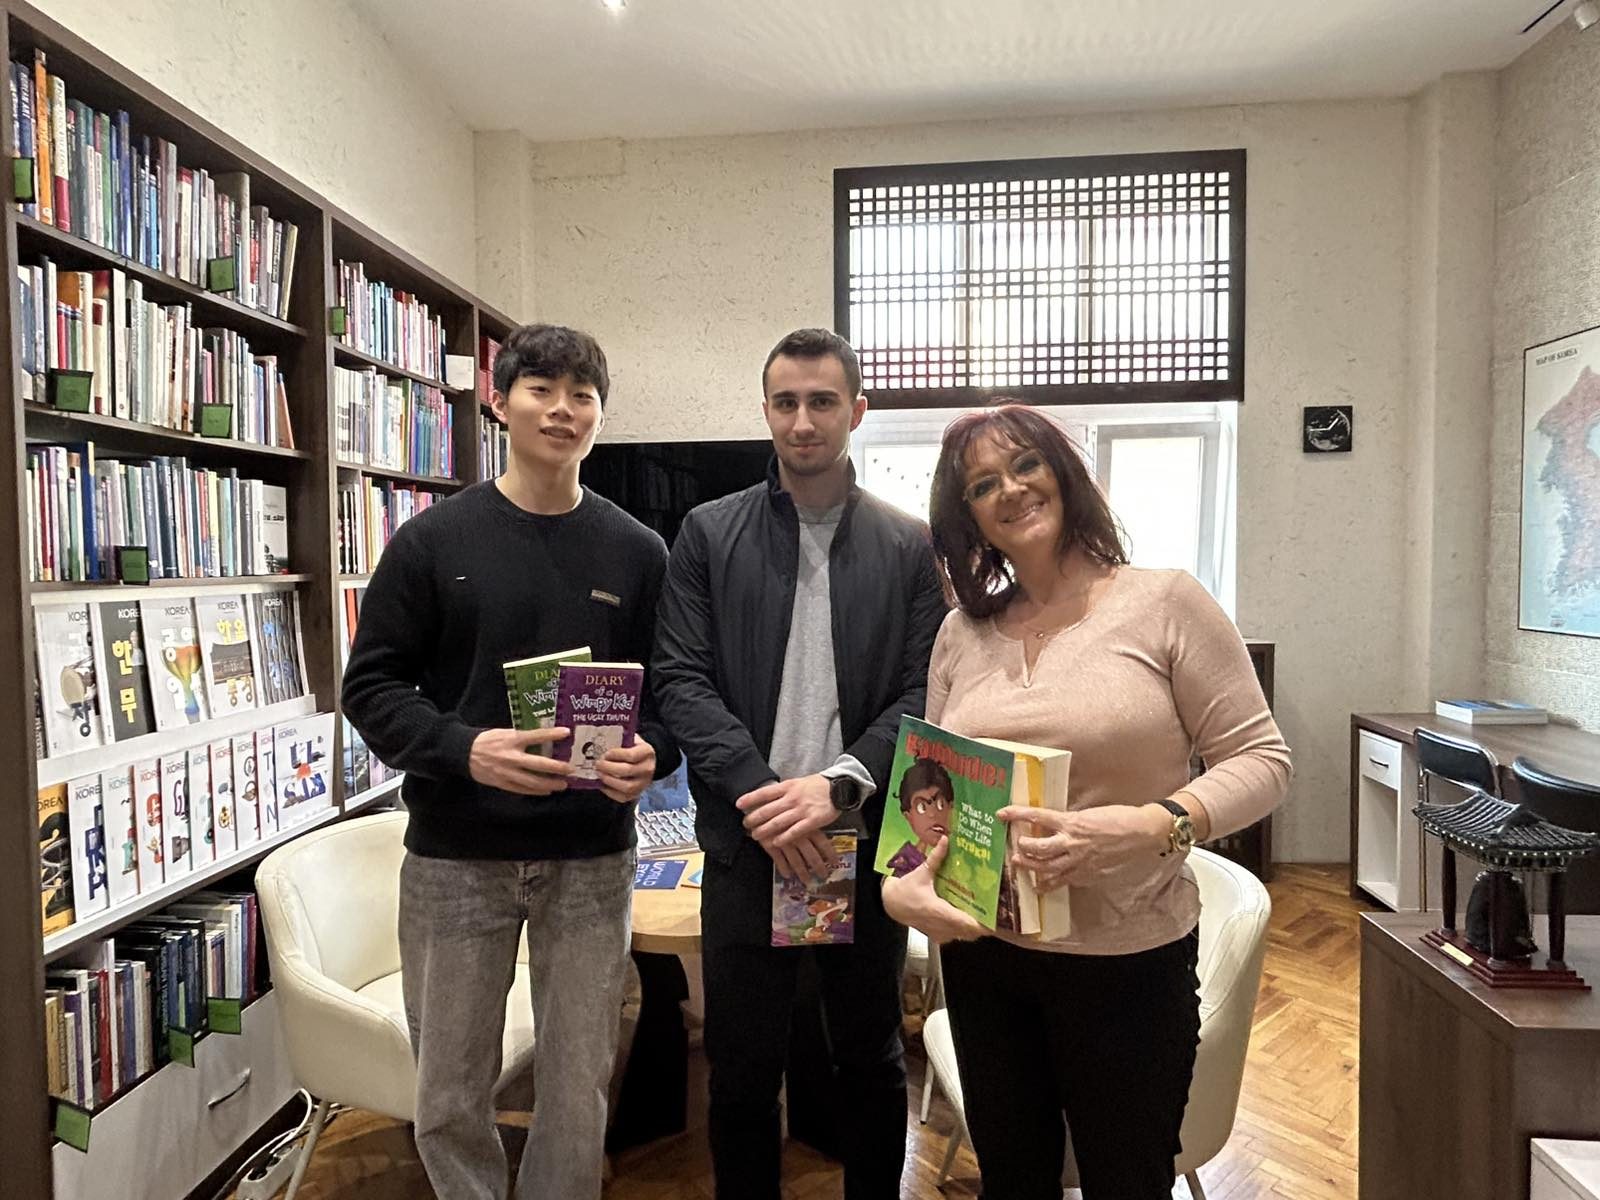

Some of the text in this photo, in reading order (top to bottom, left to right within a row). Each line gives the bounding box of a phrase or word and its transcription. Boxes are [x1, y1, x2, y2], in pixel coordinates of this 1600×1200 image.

[217, 600, 240, 611] KOREA
[264, 598, 283, 607] KOREA
[165, 606, 191, 617] KOREA
[585, 674, 625, 686] DIARY
[594, 685, 614, 697] of a
[569, 692, 636, 713] Wimpy Kid
[572, 713, 630, 722] THE UGLY TRUTH
[278, 728, 298, 739] KOREA
[75, 784, 101, 801] KORE
[961, 801, 994, 824] What to
[959, 811, 993, 837] Do When
[974, 831, 992, 848] Life
